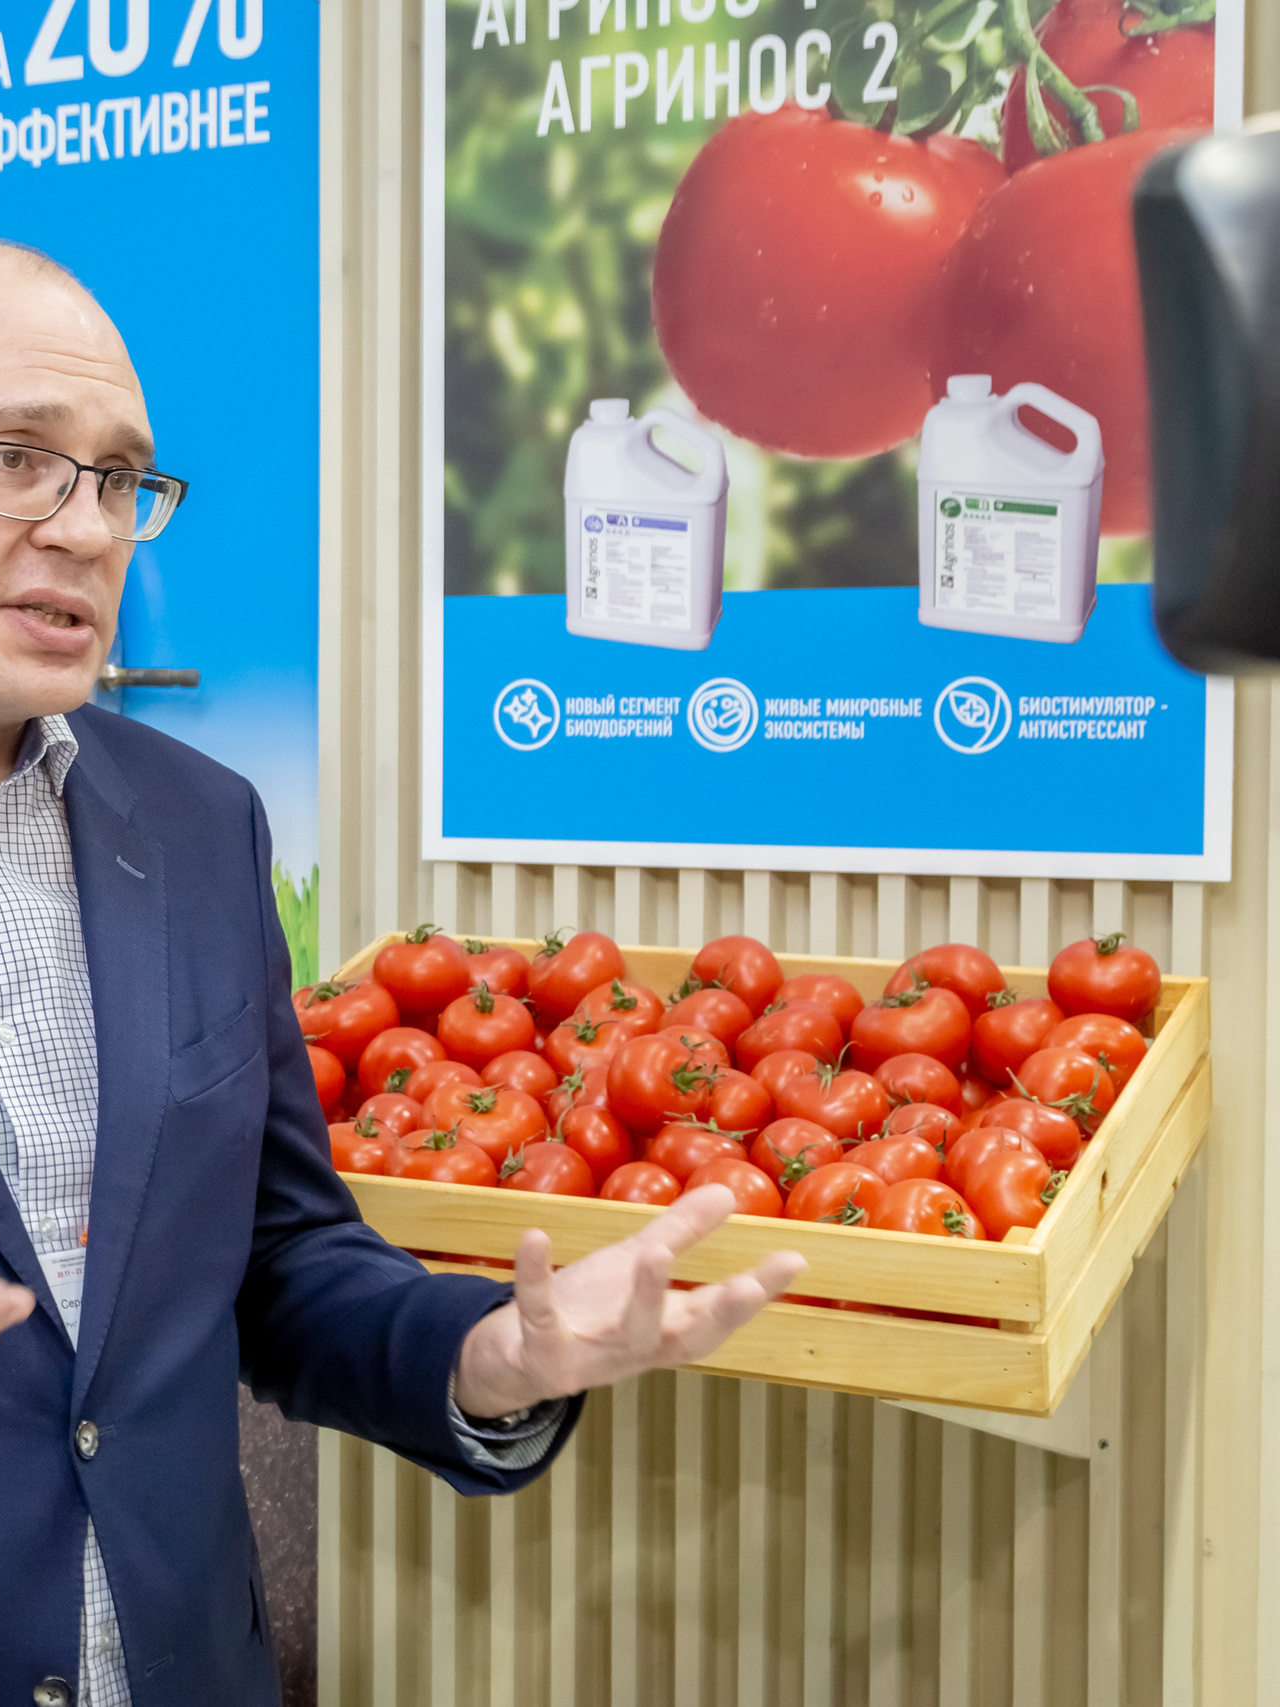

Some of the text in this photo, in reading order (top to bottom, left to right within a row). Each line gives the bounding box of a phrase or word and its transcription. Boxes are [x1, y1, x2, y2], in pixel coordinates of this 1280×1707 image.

[536, 21, 899, 137] АГРИНОС 2
[565, 694, 681, 717] НОВЫЙ СЕГМЕНТ
[764, 697, 923, 718] ЖИВЫЕ МИКРОБНЫЕ
[1019, 696, 1155, 716] БИОСТИМУЛЯТОР
[565, 716, 673, 739] БИОУДОБРЕНИЙ
[764, 720, 865, 740] ЭКОСИСТЕМЫ
[1018, 720, 1147, 740] АНТИСТРЕССАНТ
